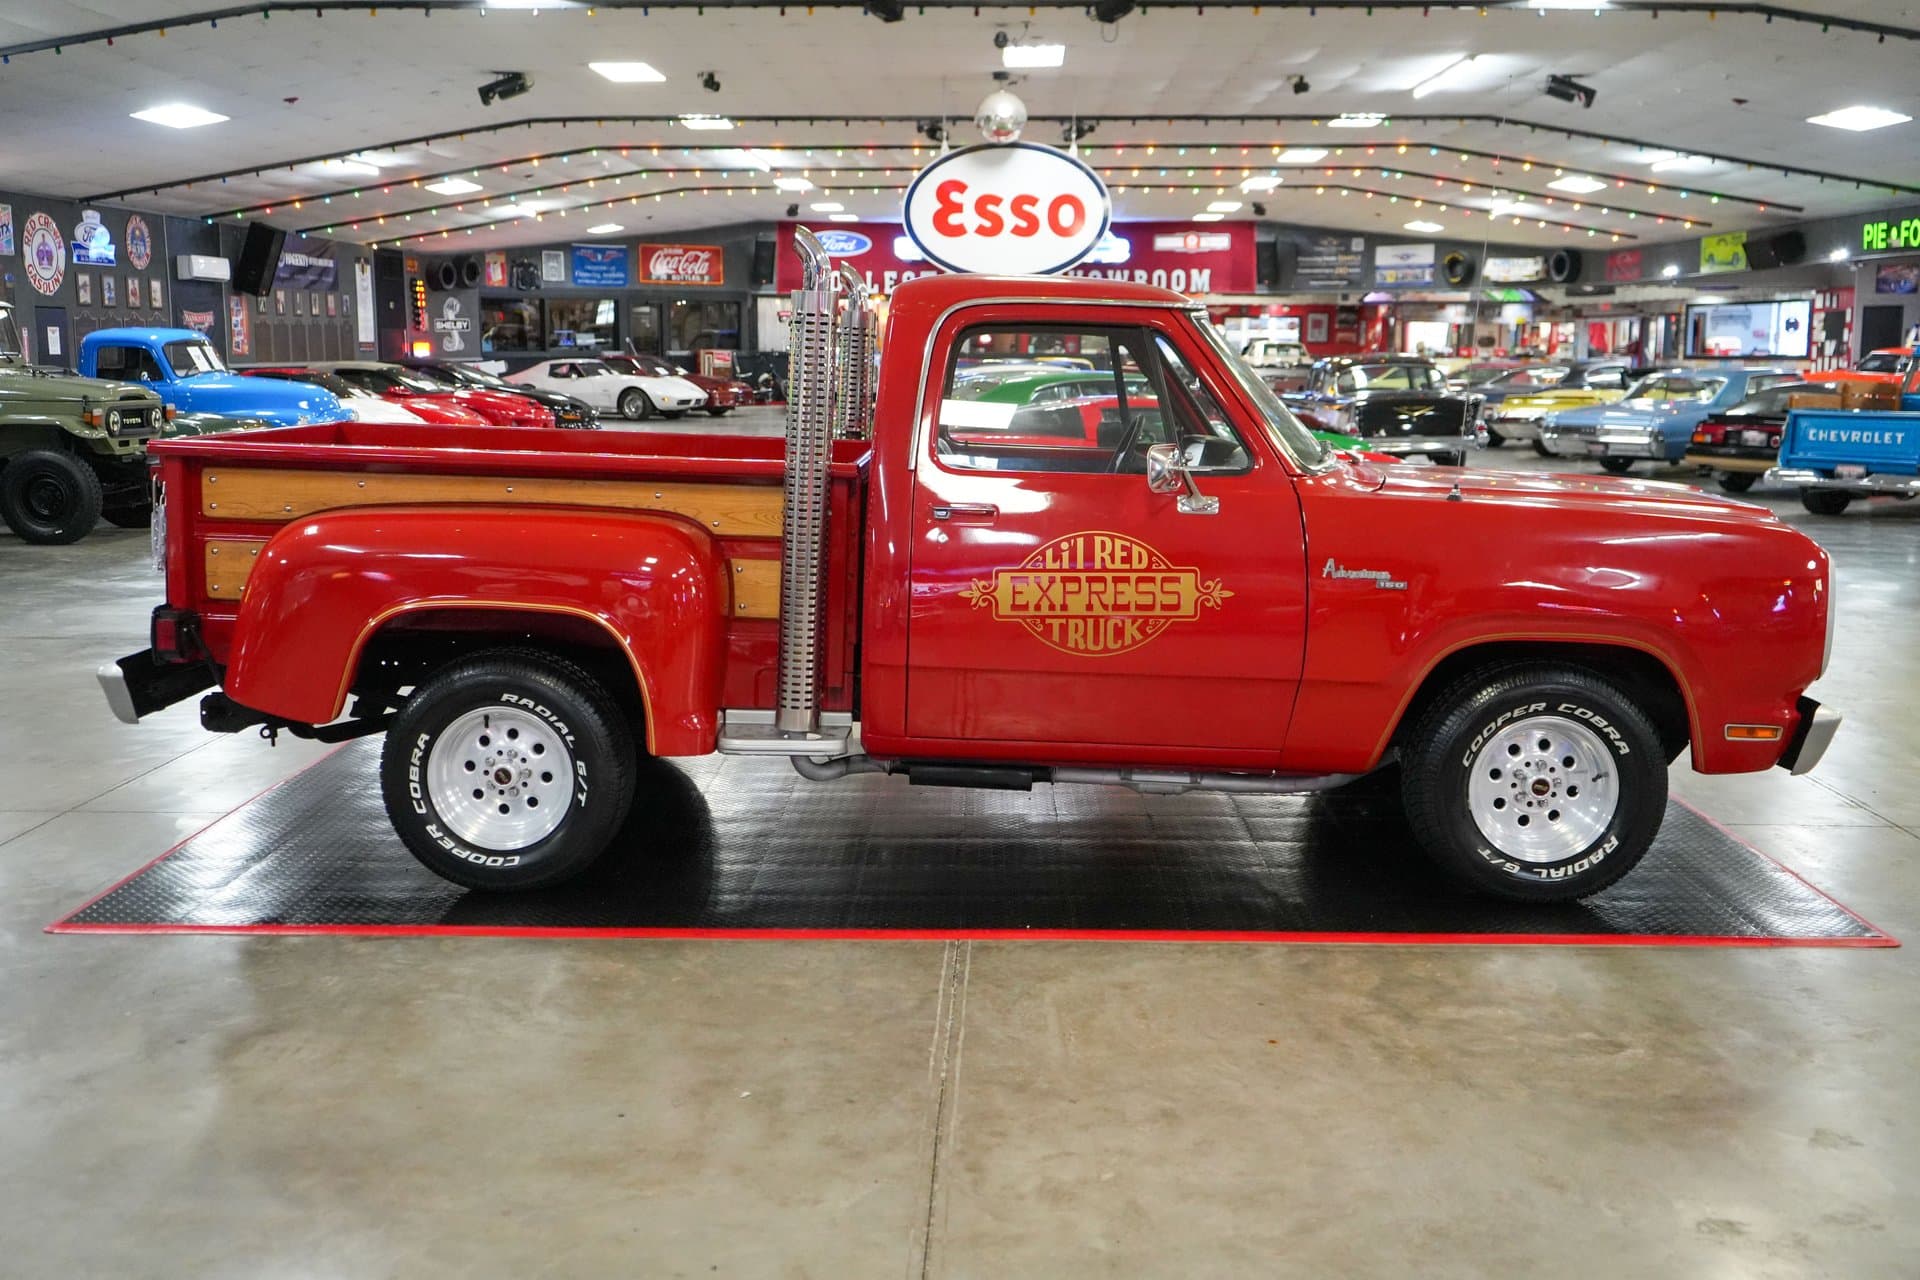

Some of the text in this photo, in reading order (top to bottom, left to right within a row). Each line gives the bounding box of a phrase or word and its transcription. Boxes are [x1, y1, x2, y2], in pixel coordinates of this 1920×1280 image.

[932, 178, 1086, 238] Esso
[24, 218, 37, 247] RED
[822, 234, 858, 250] Ford
[1863, 221, 1888, 251] PIE
[649, 250, 712, 275] Coca-Cola
[27, 263, 65, 296] GASOLINE
[1064, 268, 1212, 294] ROOM
[436, 321, 469, 329] SHELBY
[123, 417, 142, 425] TOYOTA
[1808, 428, 1905, 445] CHEVROLET
[1093, 535, 1149, 570] RED
[1009, 575, 1182, 612] EXPRESS
[1045, 618, 1145, 651] TRUCK
[500, 693, 589, 807] RADIAL G/T
[1462, 702, 1631, 768] COOPER COBRA
[409, 732, 521, 867] COOPER COBRA
[1476, 835, 1620, 879] RADIAL G/T
